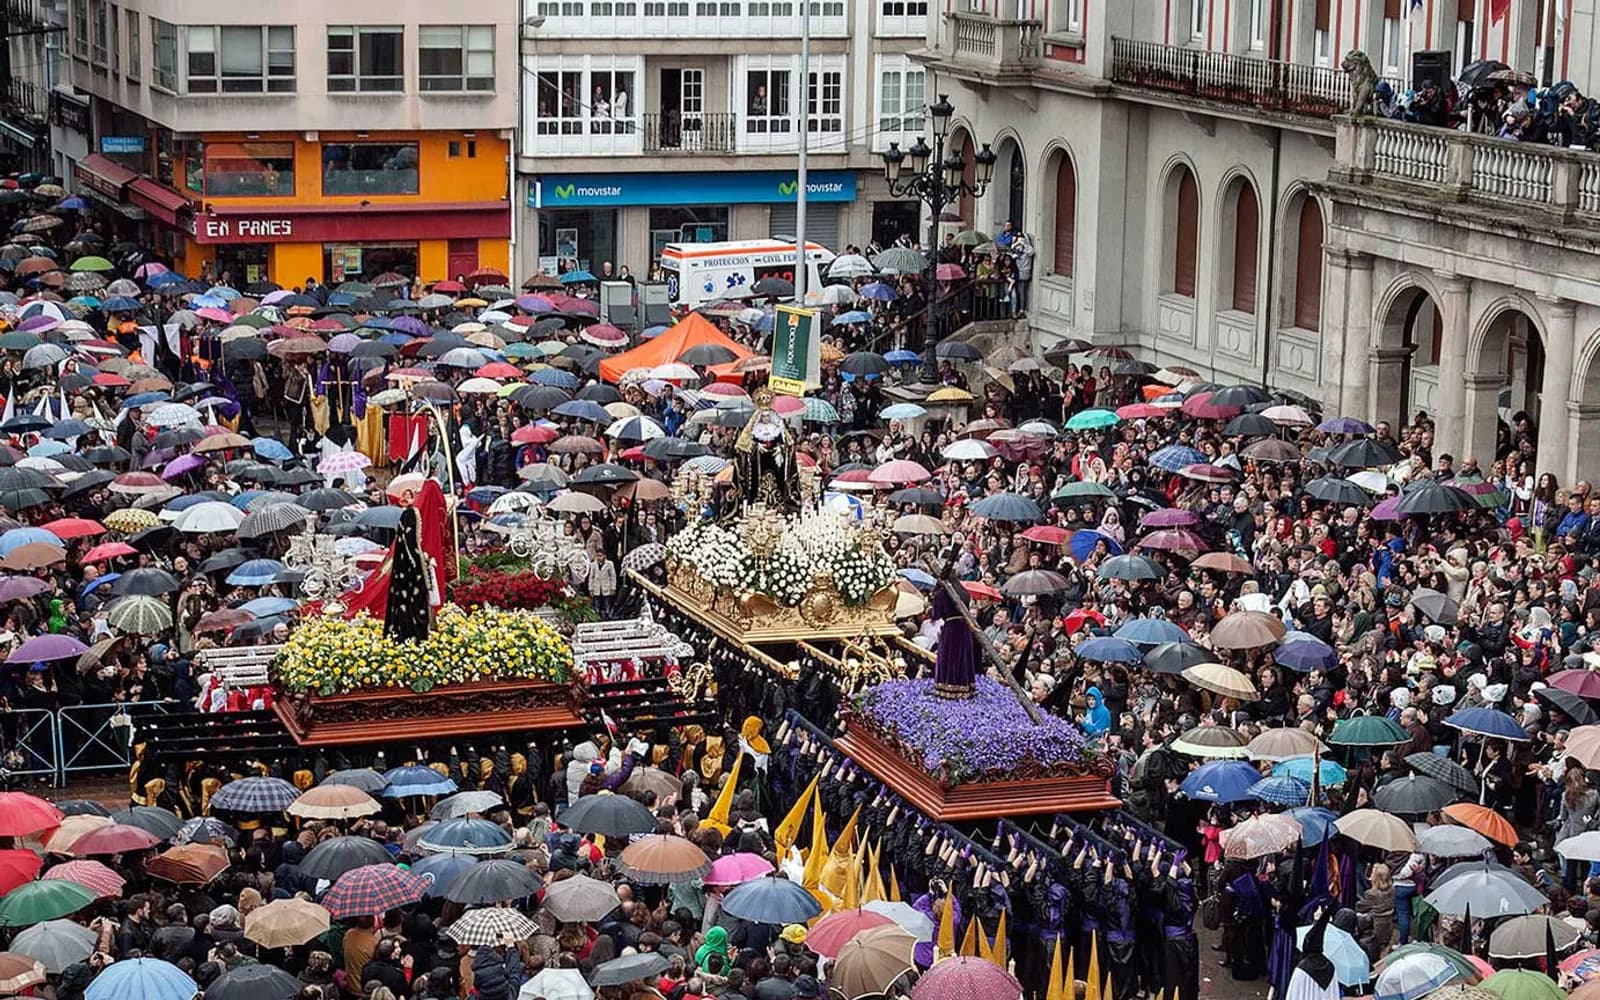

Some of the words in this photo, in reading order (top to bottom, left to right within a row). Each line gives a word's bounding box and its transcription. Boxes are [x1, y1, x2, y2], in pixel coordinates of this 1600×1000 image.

[577, 186, 622, 196] movistar
[206, 221, 229, 237] EN
[238, 220, 292, 236] PANES
[762, 254, 782, 264] CIVIL
[783, 253, 812, 262] FERL
